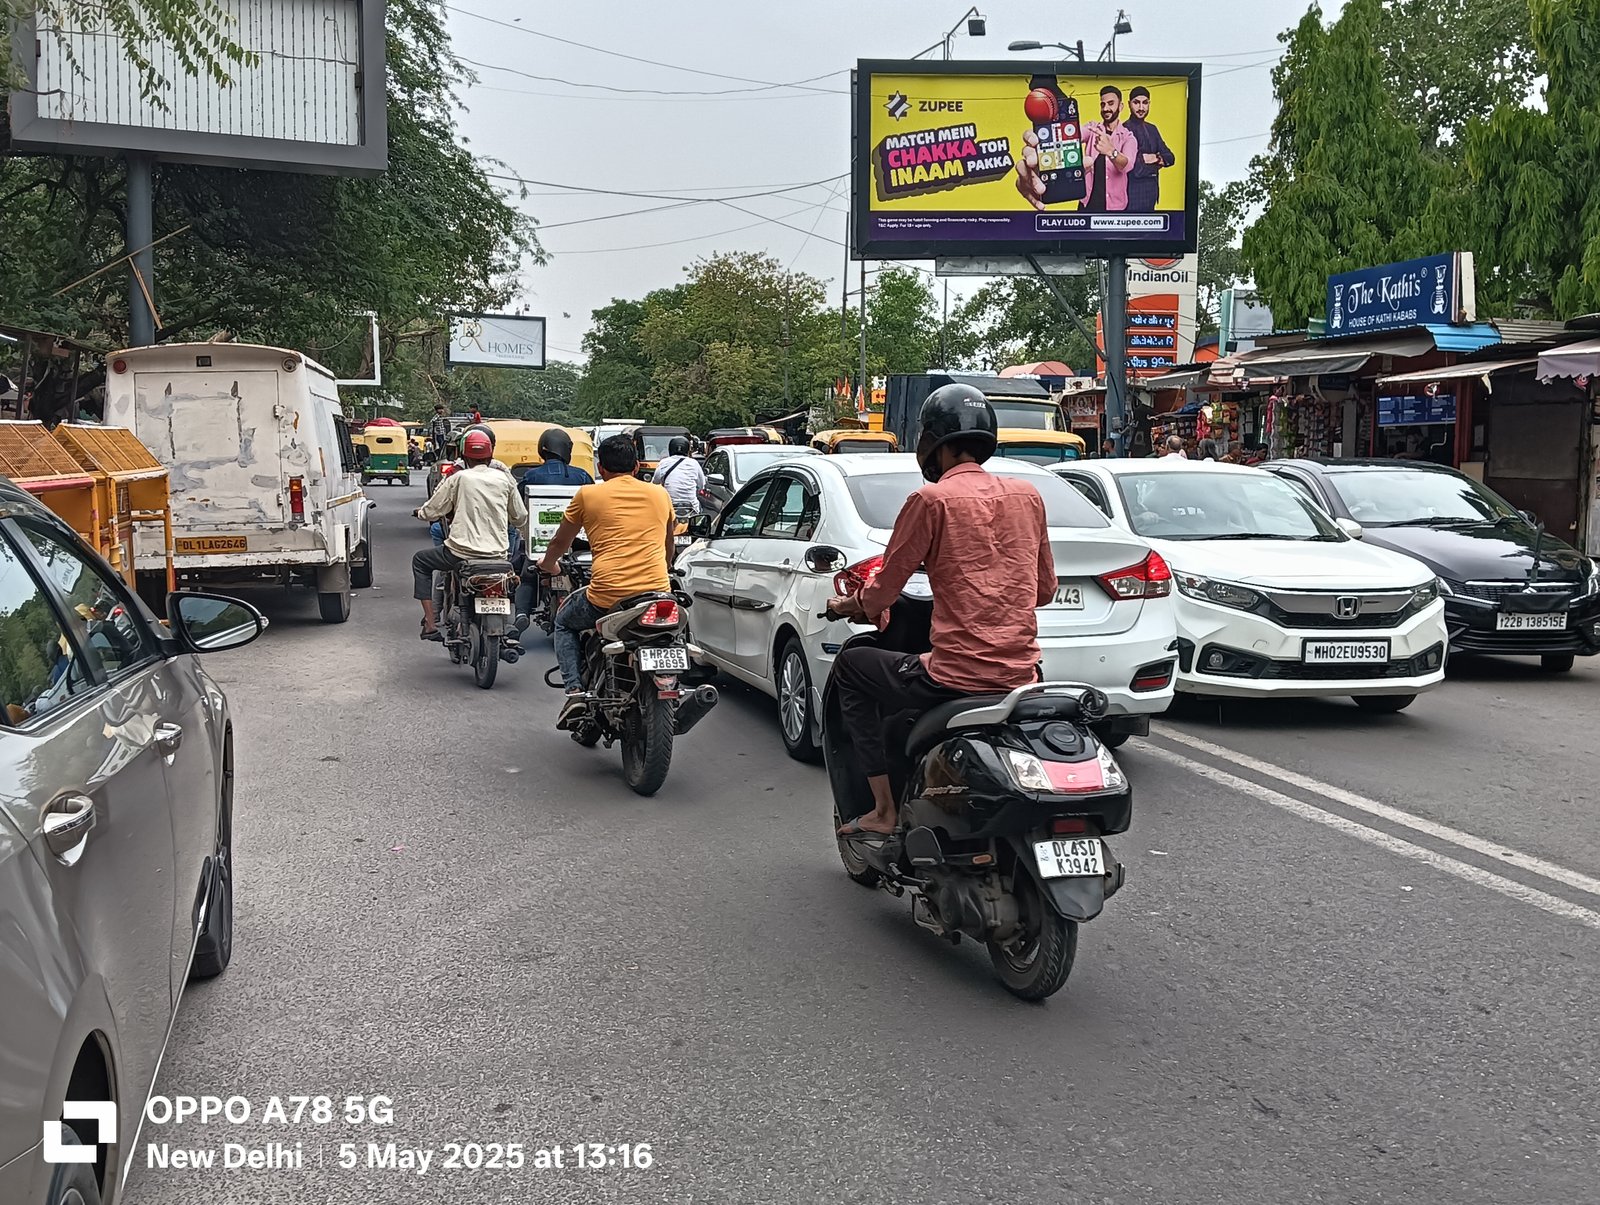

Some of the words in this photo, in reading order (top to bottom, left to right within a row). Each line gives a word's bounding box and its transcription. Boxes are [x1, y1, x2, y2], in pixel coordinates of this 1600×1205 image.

[918, 101, 964, 113] ZUPEE
[885, 131, 936, 151] MATCH
[938, 125, 976, 142] MEIN
[888, 139, 977, 169] CHAKKA
[979, 139, 1008, 155] TOH
[890, 159, 965, 187] INAAM
[967, 155, 1013, 172] PAKKA
[1041, 219, 1062, 227] PLAY
[1063, 219, 1086, 227] LUDO
[1093, 218, 1162, 227] www.zupee.com
[1128, 270, 1188, 283] IndianOil
[1347, 281, 1374, 313] The
[1377, 272, 1421, 311] Kathi's
[1348, 317, 1367, 328] HOUSE
[1367, 316, 1375, 326] OF
[1375, 312, 1392, 323] KATHI
[1392, 309, 1417, 321] KABABS
[488, 342, 533, 355] HOMES
[183, 540, 246, 550] DL1LAG2646
[1526, 616, 1565, 628] 138515E
[650, 649, 683, 659] HR26E
[1314, 646, 1386, 659] MH02EU9530
[652, 659, 685, 668] J8695
[1052, 840, 1096, 857] DL4SD
[1056, 858, 1098, 874] K3942
